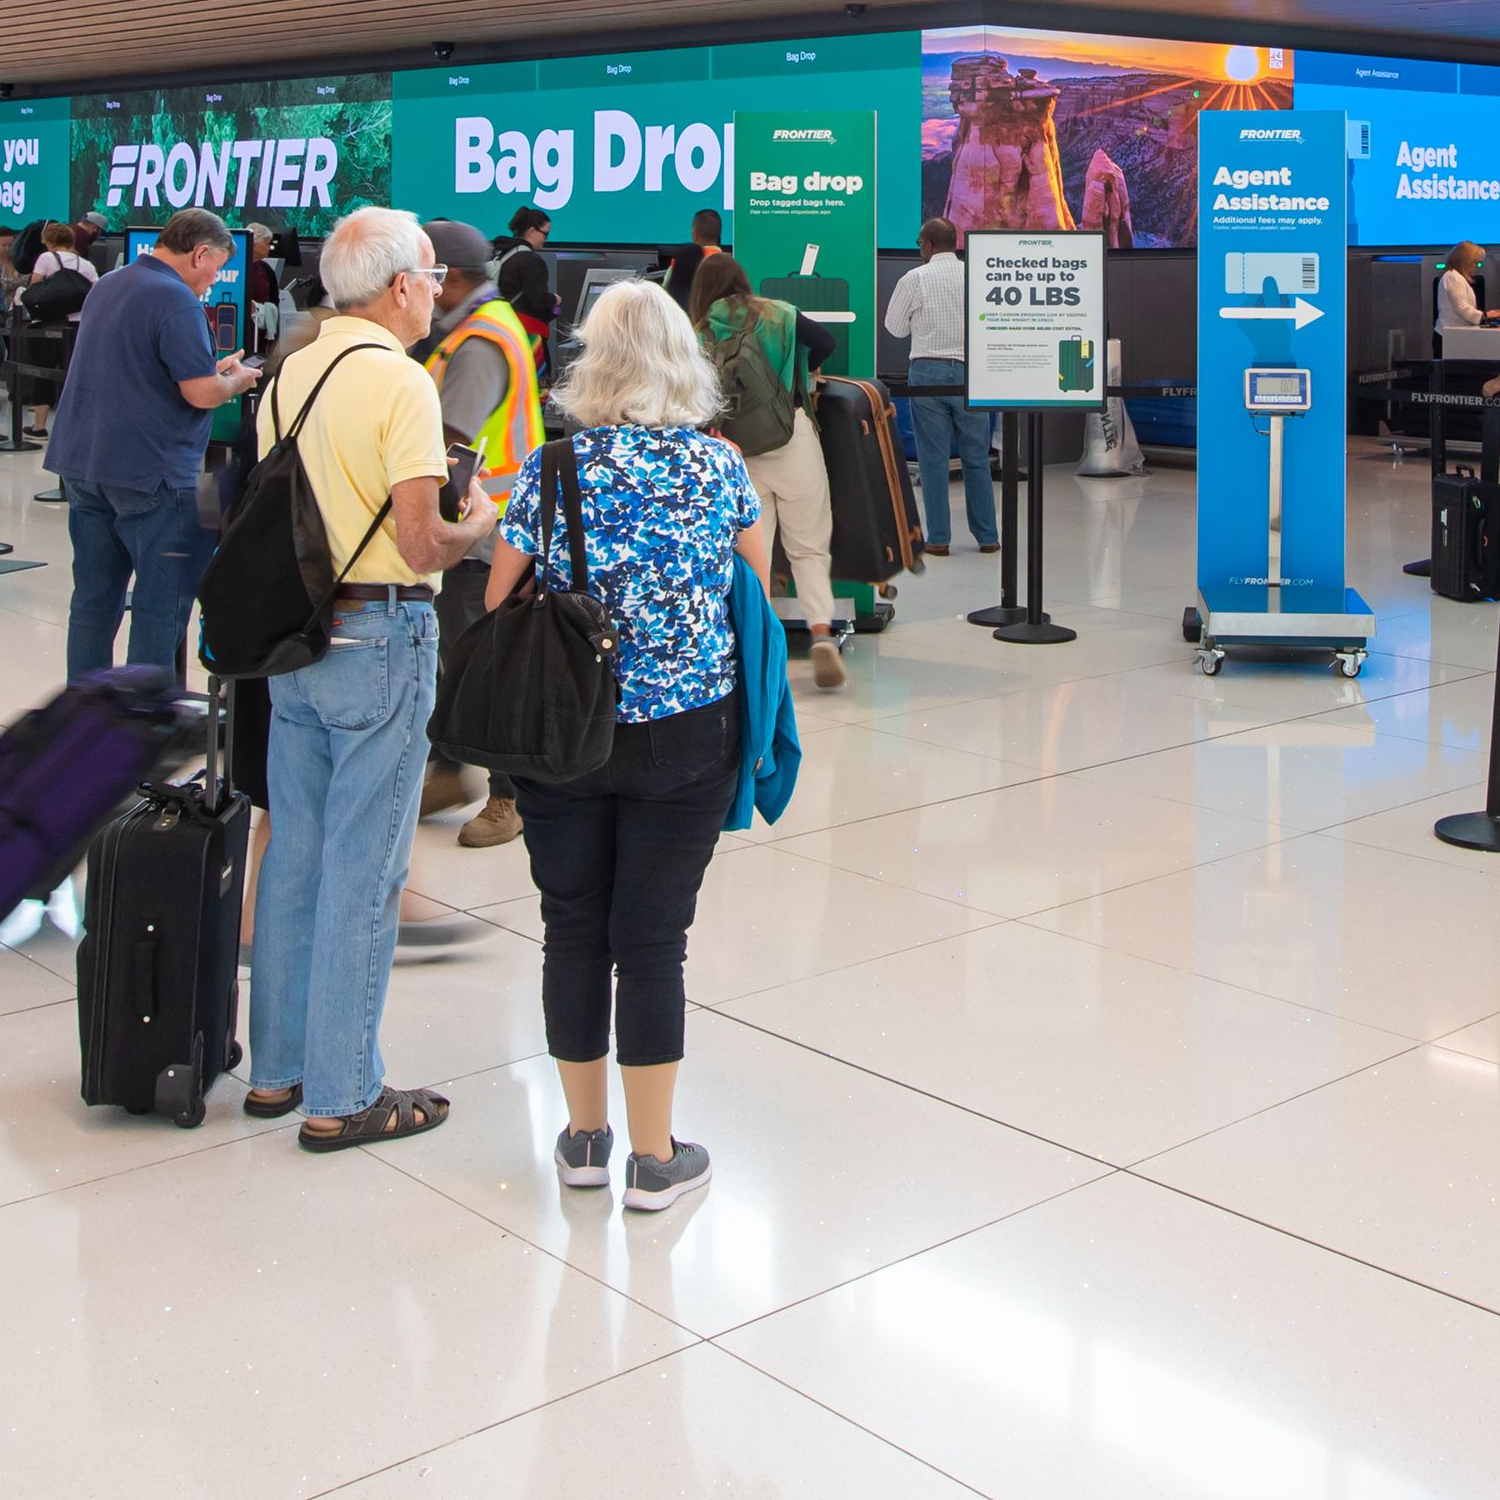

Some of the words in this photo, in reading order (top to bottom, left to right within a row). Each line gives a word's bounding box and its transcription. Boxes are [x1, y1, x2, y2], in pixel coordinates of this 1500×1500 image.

[786, 50, 800, 63] Bag
[800, 50, 816, 62] Drop
[607, 63, 619, 75] Bag
[619, 63, 632, 74] Drop
[1356, 68, 1371, 78] Agent
[1372, 69, 1399, 79] Assistance
[449, 76, 459, 86] Bag
[459, 75, 470, 86] Drop
[772, 129, 833, 140] FRONTIER
[1239, 129, 1301, 139] FRONTIER
[4, 138, 39, 172] you
[1396, 141, 1458, 172] Agent
[455, 116, 574, 210] Bag
[106, 137, 338, 208] FRONTIER
[1212, 166, 1292, 190] Agent
[750, 171, 798, 195] Bag
[803, 171, 863, 195] drop
[1396, 173, 1500, 200] Assistance
[749, 199, 770, 207] Drop
[772, 199, 801, 207] tagged
[803, 199, 823, 207] bags
[1212, 193, 1330, 211] Assistance
[1213, 216, 1256, 224] Additional
[1258, 216, 1276, 224] fees
[1278, 218, 1296, 226] may
[1298, 216, 1323, 226] apply.
[986, 258, 1048, 268] Checked
[1052, 258, 1088, 270] bags
[214, 269, 239, 283] our
[986, 273, 1012, 282] can
[1015, 270, 1033, 282] be
[1037, 272, 1056, 284] up
[1060, 271, 1075, 282] to
[986, 286, 1022, 306] 40
[1030, 286, 1080, 306] LBS
[1162, 387, 1197, 397] FLYFR
[1228, 577, 1314, 586] FLYFRONER.COM
